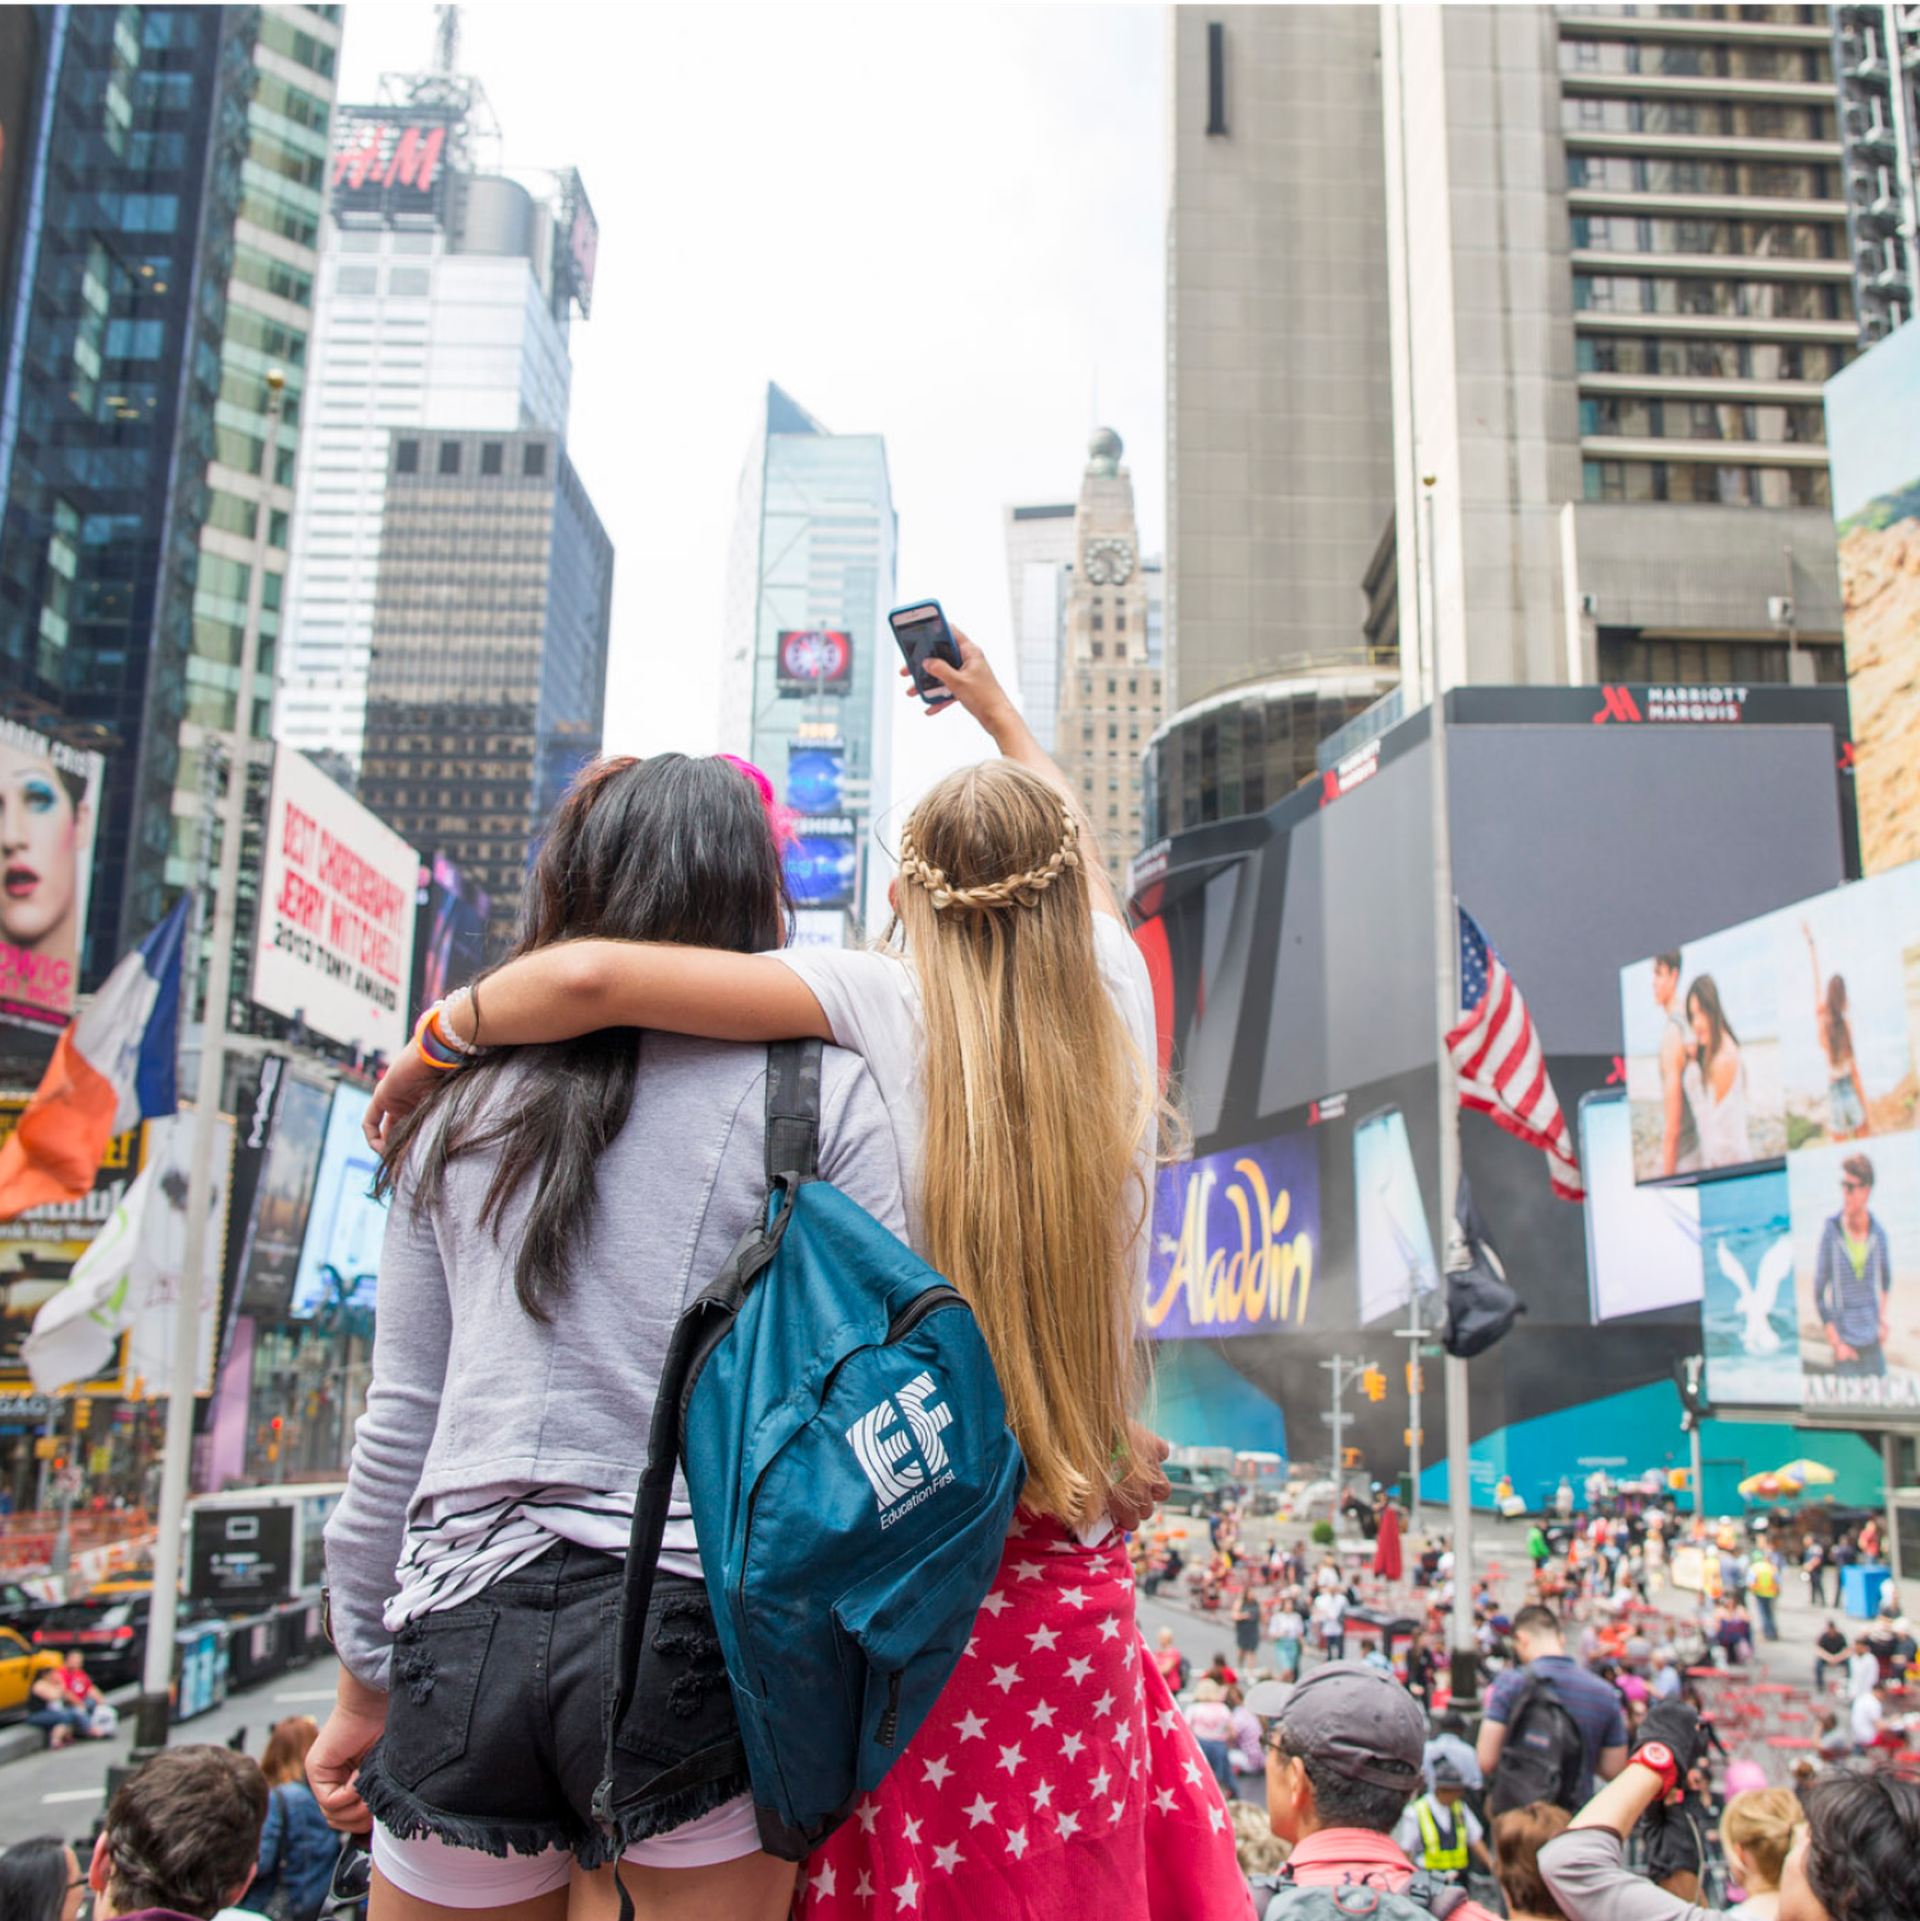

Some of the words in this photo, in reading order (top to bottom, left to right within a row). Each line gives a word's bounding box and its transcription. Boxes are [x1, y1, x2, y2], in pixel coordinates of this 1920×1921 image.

[1647, 687, 1749, 703] MARRIOTT
[1649, 703, 1738, 721] MARQUIS
[790, 817, 855, 835] SHIBA
[317, 943, 352, 978] TONY
[1141, 1158, 1313, 1329] Aladdin
[845, 1370, 954, 1513] EF
[880, 1484, 933, 1531] Education
[932, 1468, 957, 1494] First
